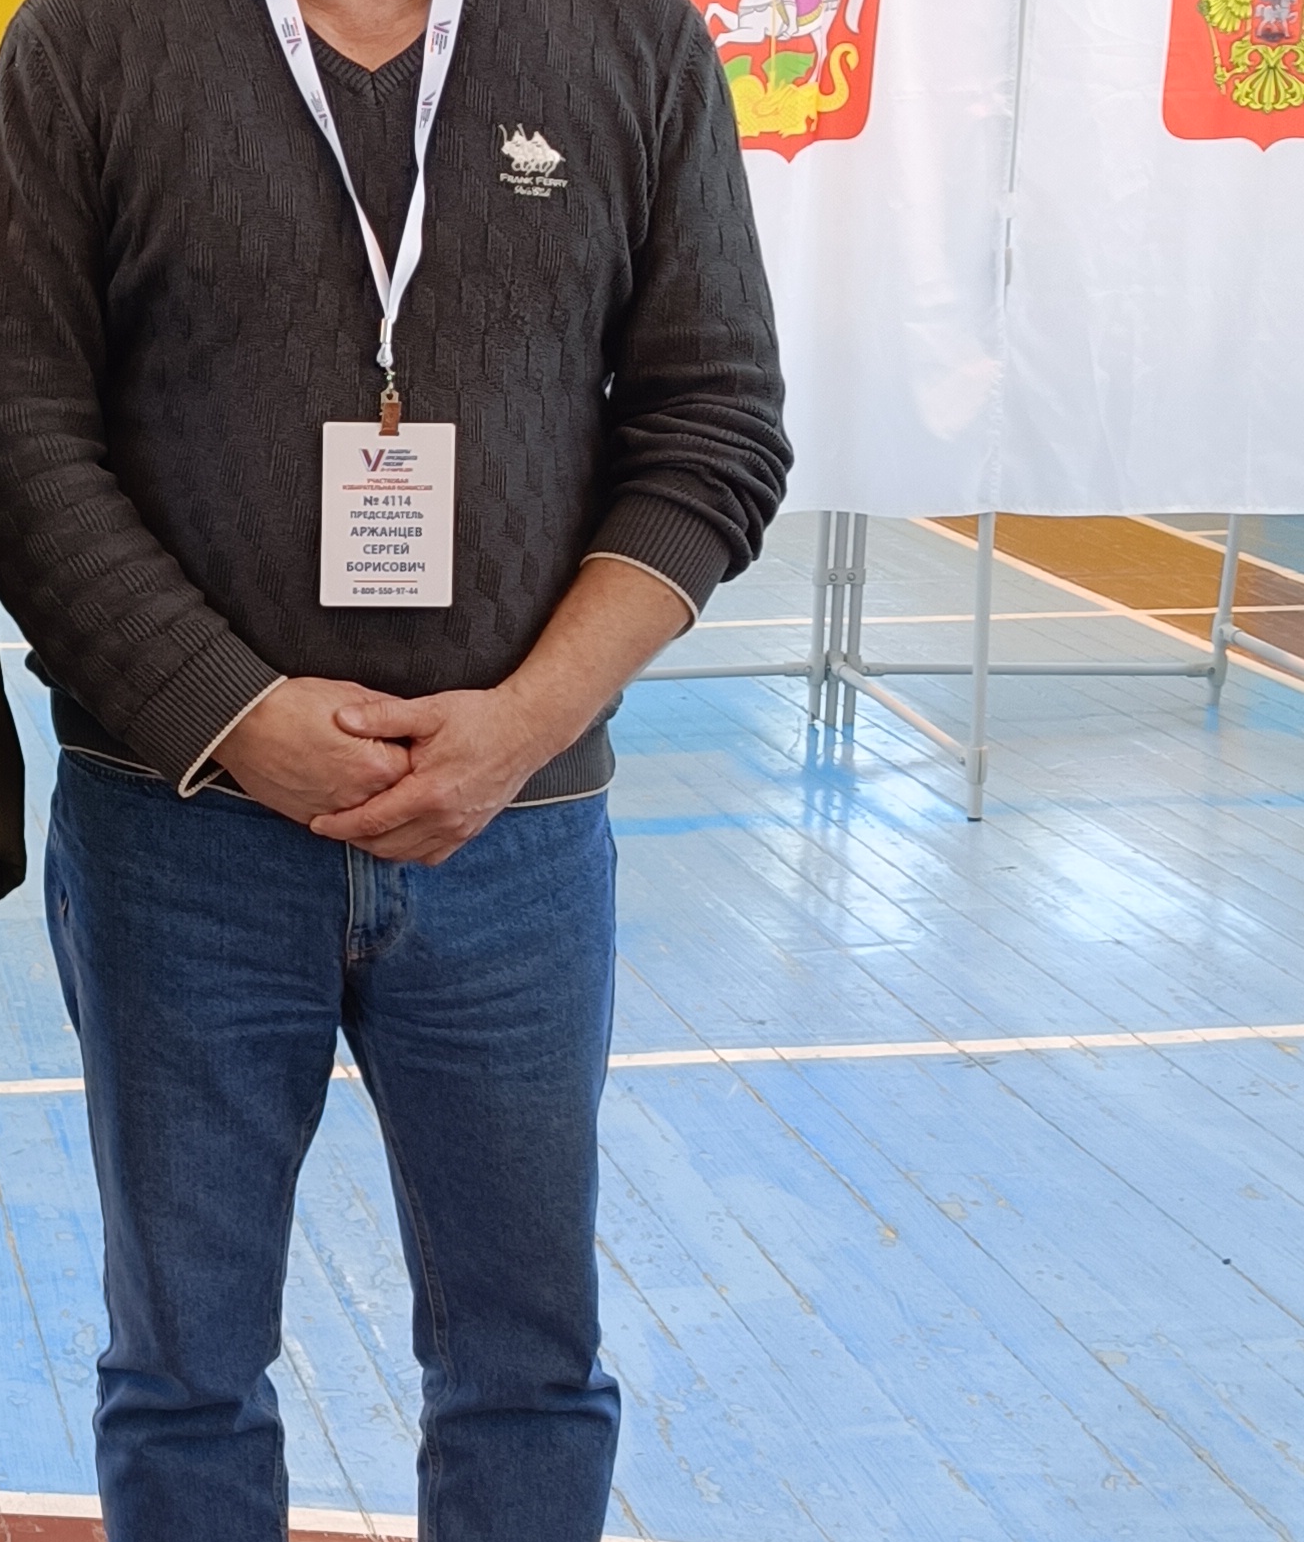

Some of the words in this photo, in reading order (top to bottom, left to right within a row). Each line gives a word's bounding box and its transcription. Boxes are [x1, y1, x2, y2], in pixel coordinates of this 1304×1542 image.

[363, 495, 379, 506] №
[382, 495, 412, 507] 4114
[350, 510, 424, 520] ПРЕДСЕДАТЕЛЬ
[350, 526, 423, 539] АРЖАНЦЕВ
[363, 542, 410, 555] СЕРГЕЙ
[346, 561, 426, 572] БОРИСОВИЧ
